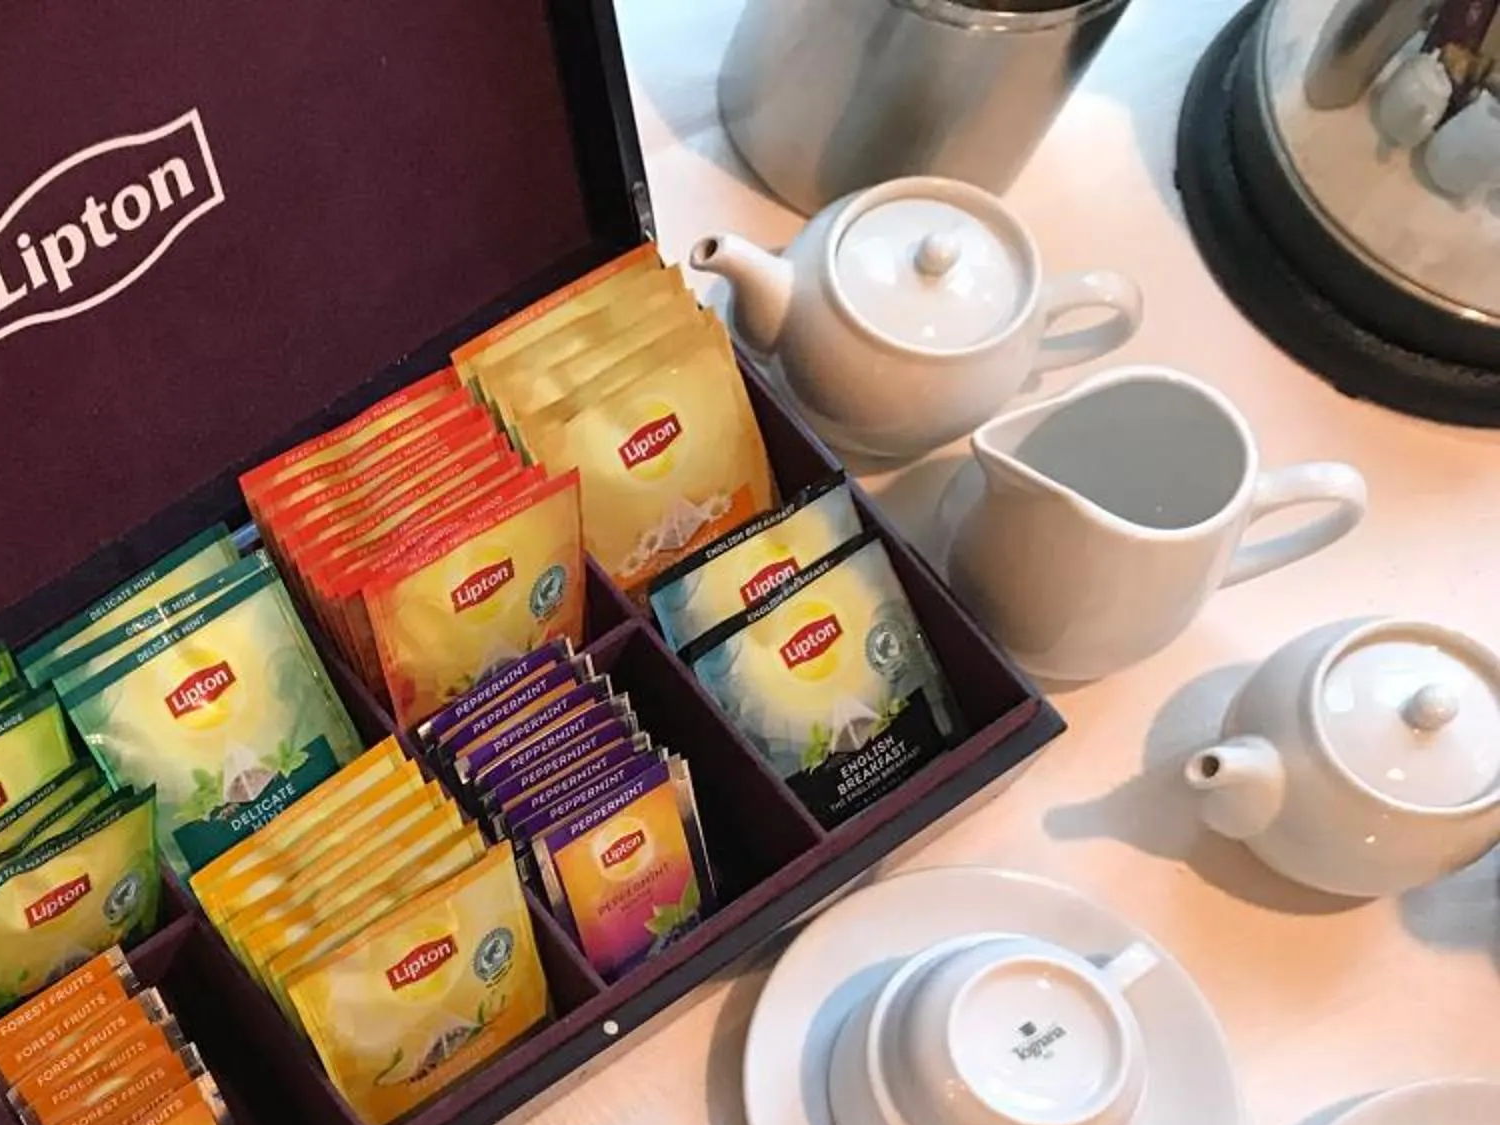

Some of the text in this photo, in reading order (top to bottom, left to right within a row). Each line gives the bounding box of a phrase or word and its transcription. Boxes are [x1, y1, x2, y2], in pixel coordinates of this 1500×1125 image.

[622, 419, 677, 463] Lipton
[456, 565, 510, 606] Lipton
[745, 565, 795, 602] Lipton
[784, 621, 838, 661] Lipton
[171, 669, 229, 710] Lipton
[455, 661, 529, 718] PEPPERMINT
[472, 679, 548, 735] PEPPERMINT
[493, 699, 568, 752] PEPPERMINT
[510, 717, 586, 769] PEPPERMINT
[520, 735, 597, 787] PEPPERMINT
[531, 756, 609, 808] PEPPERMINT
[837, 740, 907, 796] BREAKFAST
[840, 735, 895, 778] ENGLISH
[231, 782, 297, 831] DELICATE
[549, 769, 625, 820] PEPPERMINT
[570, 781, 646, 835] PEPPERMINT
[605, 835, 640, 863] Lipton
[30, 881, 86, 922] Lipton
[393, 942, 452, 984] Lipton
[0, 970, 95, 1037] FOREST FRUITS
[15, 992, 108, 1061] FOREST FRUITS
[38, 1015, 128, 1087] FOREST FRUITS
[52, 1040, 147, 1105] FOREST FRUITS
[121, 1067, 166, 1102] FRUITS
